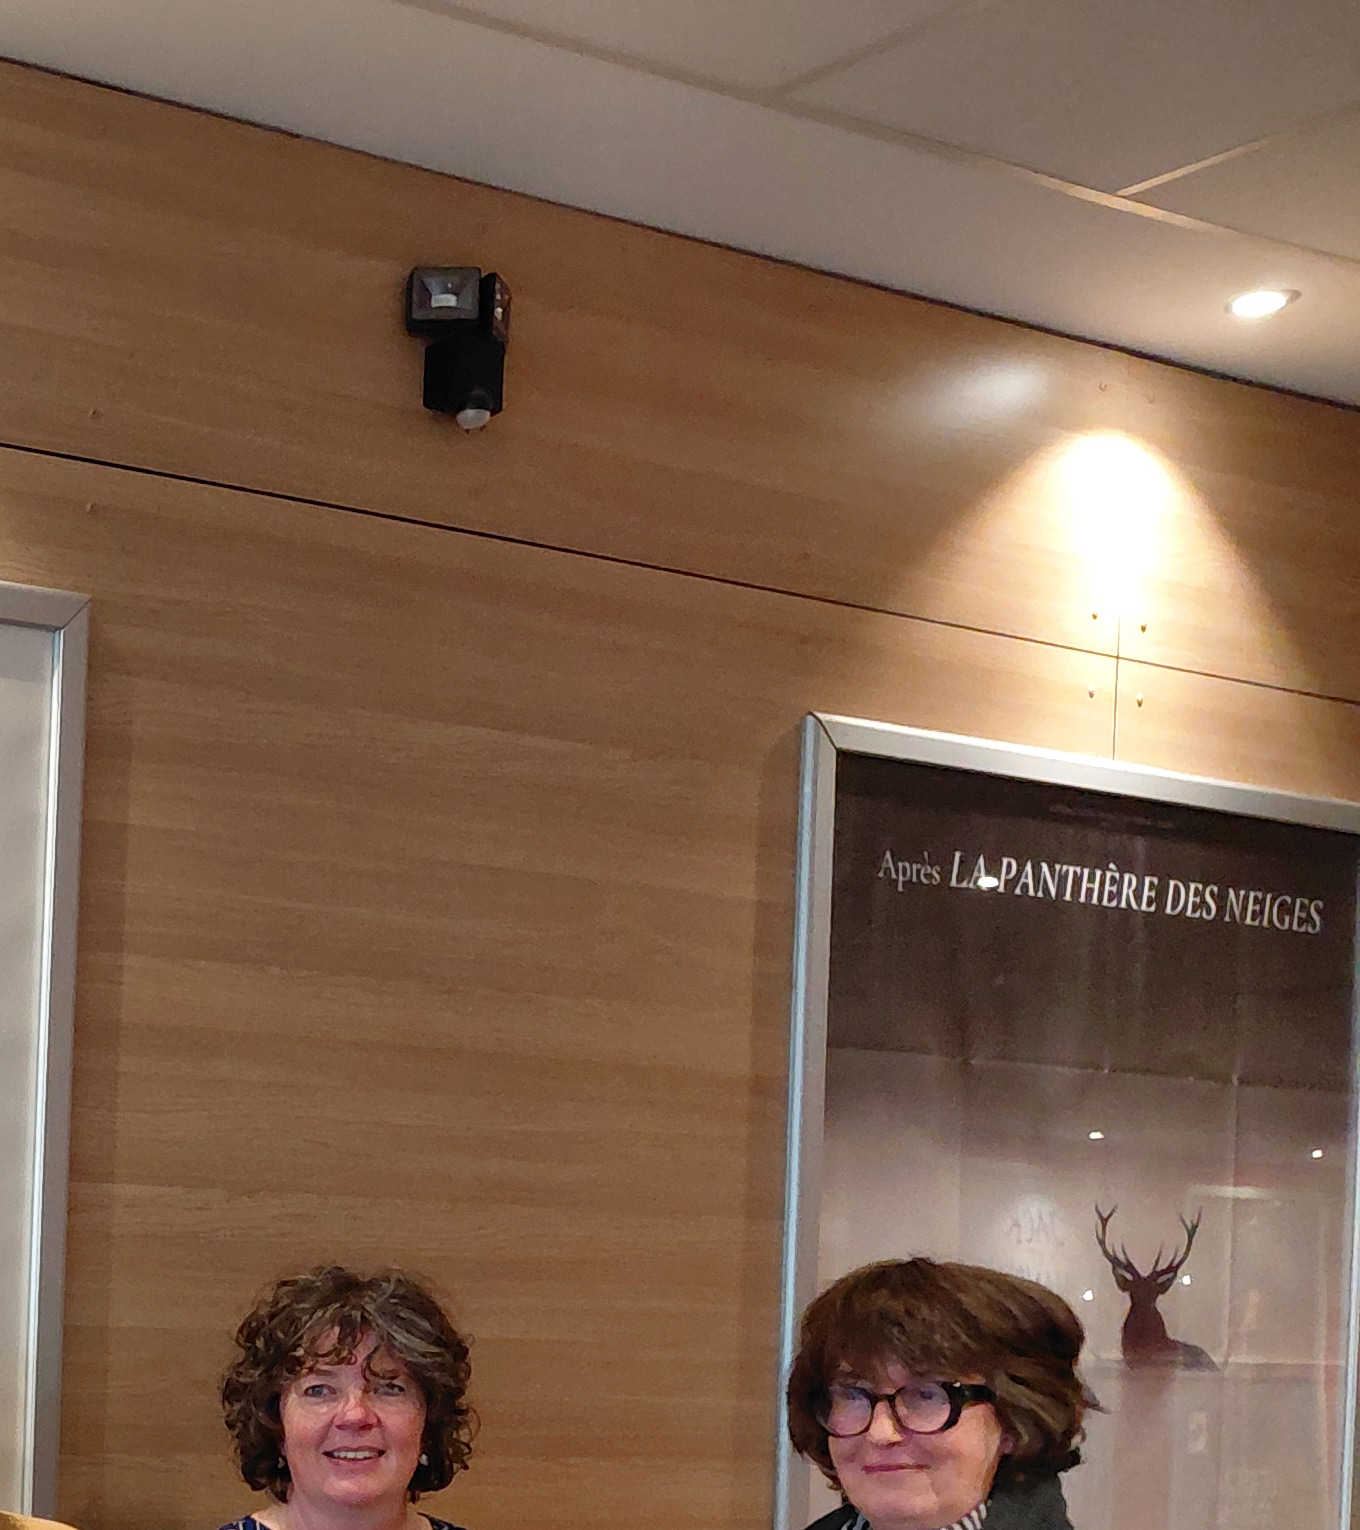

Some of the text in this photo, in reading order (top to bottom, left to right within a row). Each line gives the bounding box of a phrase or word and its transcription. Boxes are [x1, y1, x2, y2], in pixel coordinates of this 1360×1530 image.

[877, 850, 1325, 934] Après LA PANTHÈRE DES NEIGES
